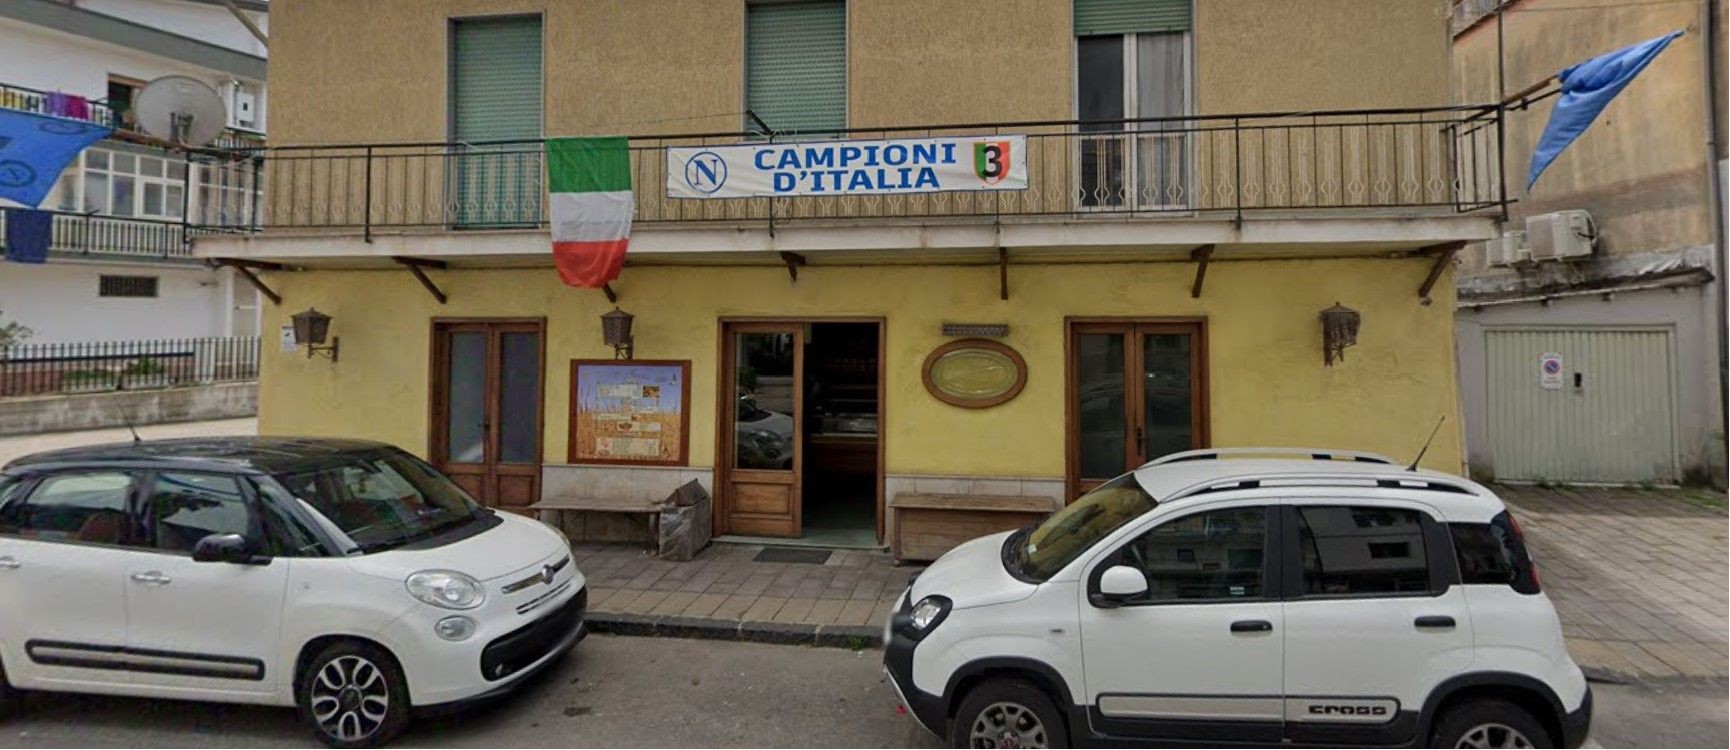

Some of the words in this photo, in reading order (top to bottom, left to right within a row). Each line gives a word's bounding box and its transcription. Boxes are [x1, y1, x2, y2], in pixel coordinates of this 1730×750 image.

[754, 144, 956, 170] CAMPIONI
[982, 145, 1003, 178] 3
[693, 158, 717, 187] N
